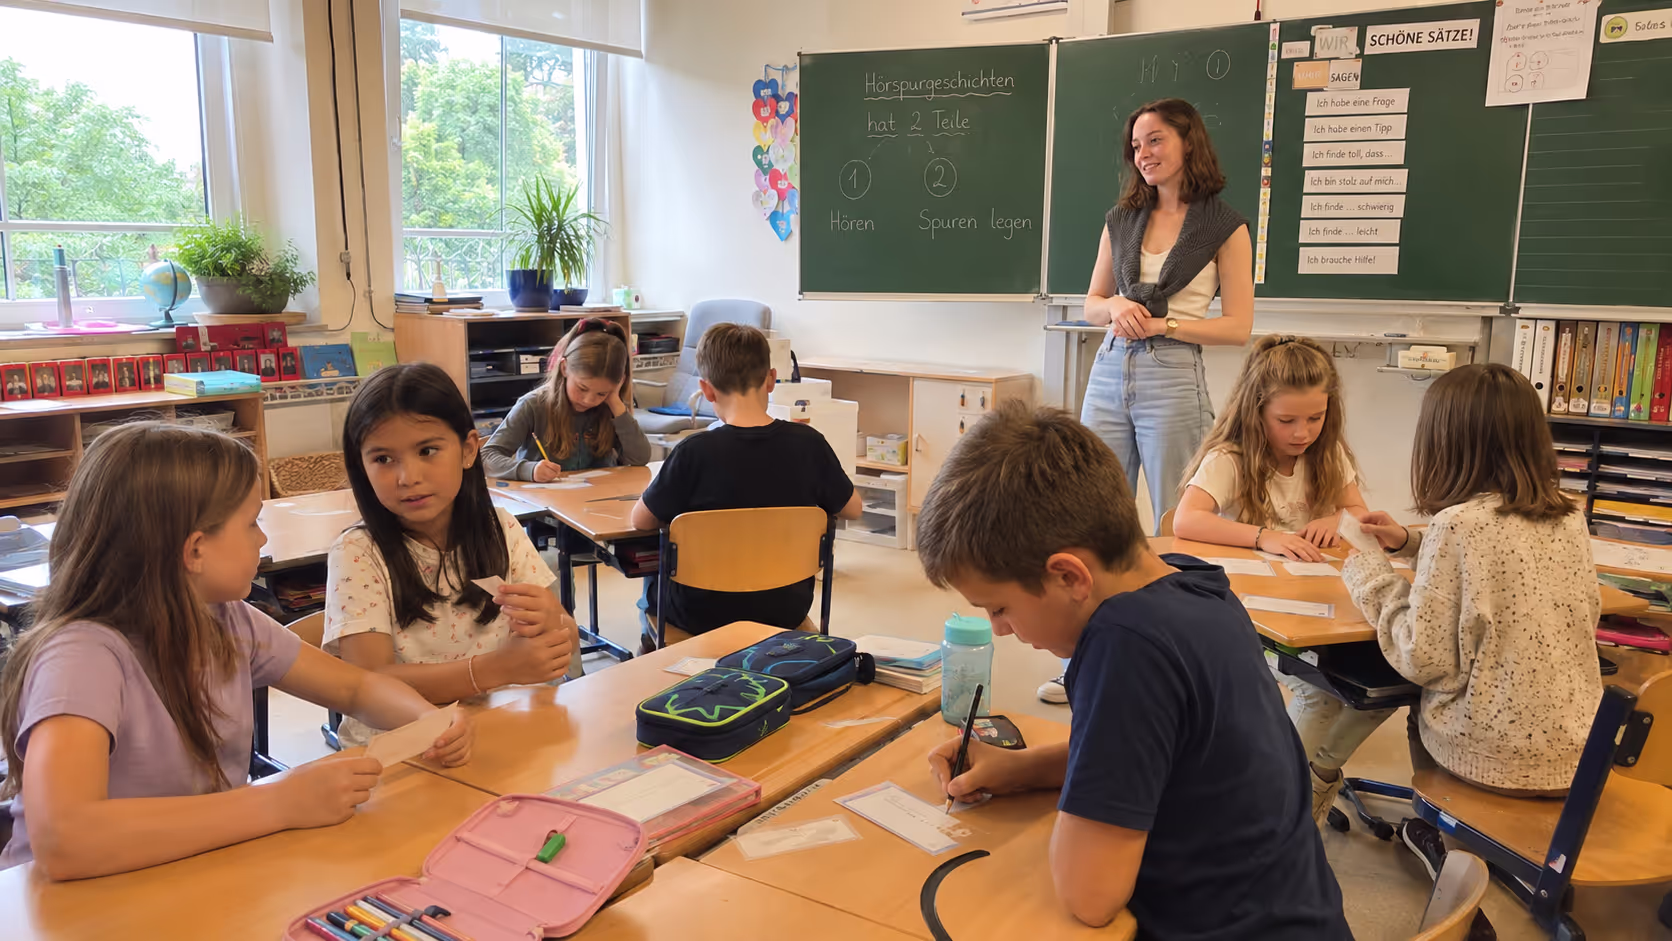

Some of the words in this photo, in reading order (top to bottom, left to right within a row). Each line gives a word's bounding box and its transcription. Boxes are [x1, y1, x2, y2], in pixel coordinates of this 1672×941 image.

[1319, 36, 1349, 51] WIR
[1369, 31, 1423, 47] SCHÖNE
[1427, 28, 1474, 43] SÄTZE!
[1330, 72, 1360, 83] SAGEN
[865, 69, 1015, 101] Hörspurgeschichten
[1316, 99, 1329, 108] Ich
[1330, 98, 1350, 107] habe
[1352, 97, 1370, 106] eine
[1372, 96, 1396, 108] Frage
[867, 111, 896, 131] hat
[910, 111, 922, 130] 2
[932, 109, 971, 129] Teile
[1313, 125, 1325, 134] Ich
[1328, 124, 1348, 133] habe
[1350, 123, 1372, 133] einen
[1374, 122, 1393, 135] Tipp
[1312, 150, 1324, 159] Ich
[1326, 149, 1346, 159] finde
[1348, 149, 1363, 160] toll,
[1310, 177, 1322, 186] Ich
[1324, 177, 1337, 186] bin
[1338, 177, 1357, 186] stolz
[1359, 176, 1373, 186] auf
[1310, 202, 1322, 211] Ich
[1324, 202, 1344, 211] finde
[1357, 202, 1395, 213] schwierig
[830, 209, 875, 231] Hören
[918, 208, 978, 240] Spuren
[991, 207, 1033, 240] legen
[1308, 227, 1320, 236] Ich
[1323, 227, 1342, 236] finde
[1356, 226, 1378, 236] leicht
[1307, 255, 1319, 264] Ich
[1320, 255, 1353, 264] brauche
[1354, 254, 1376, 264] Hilfe!
